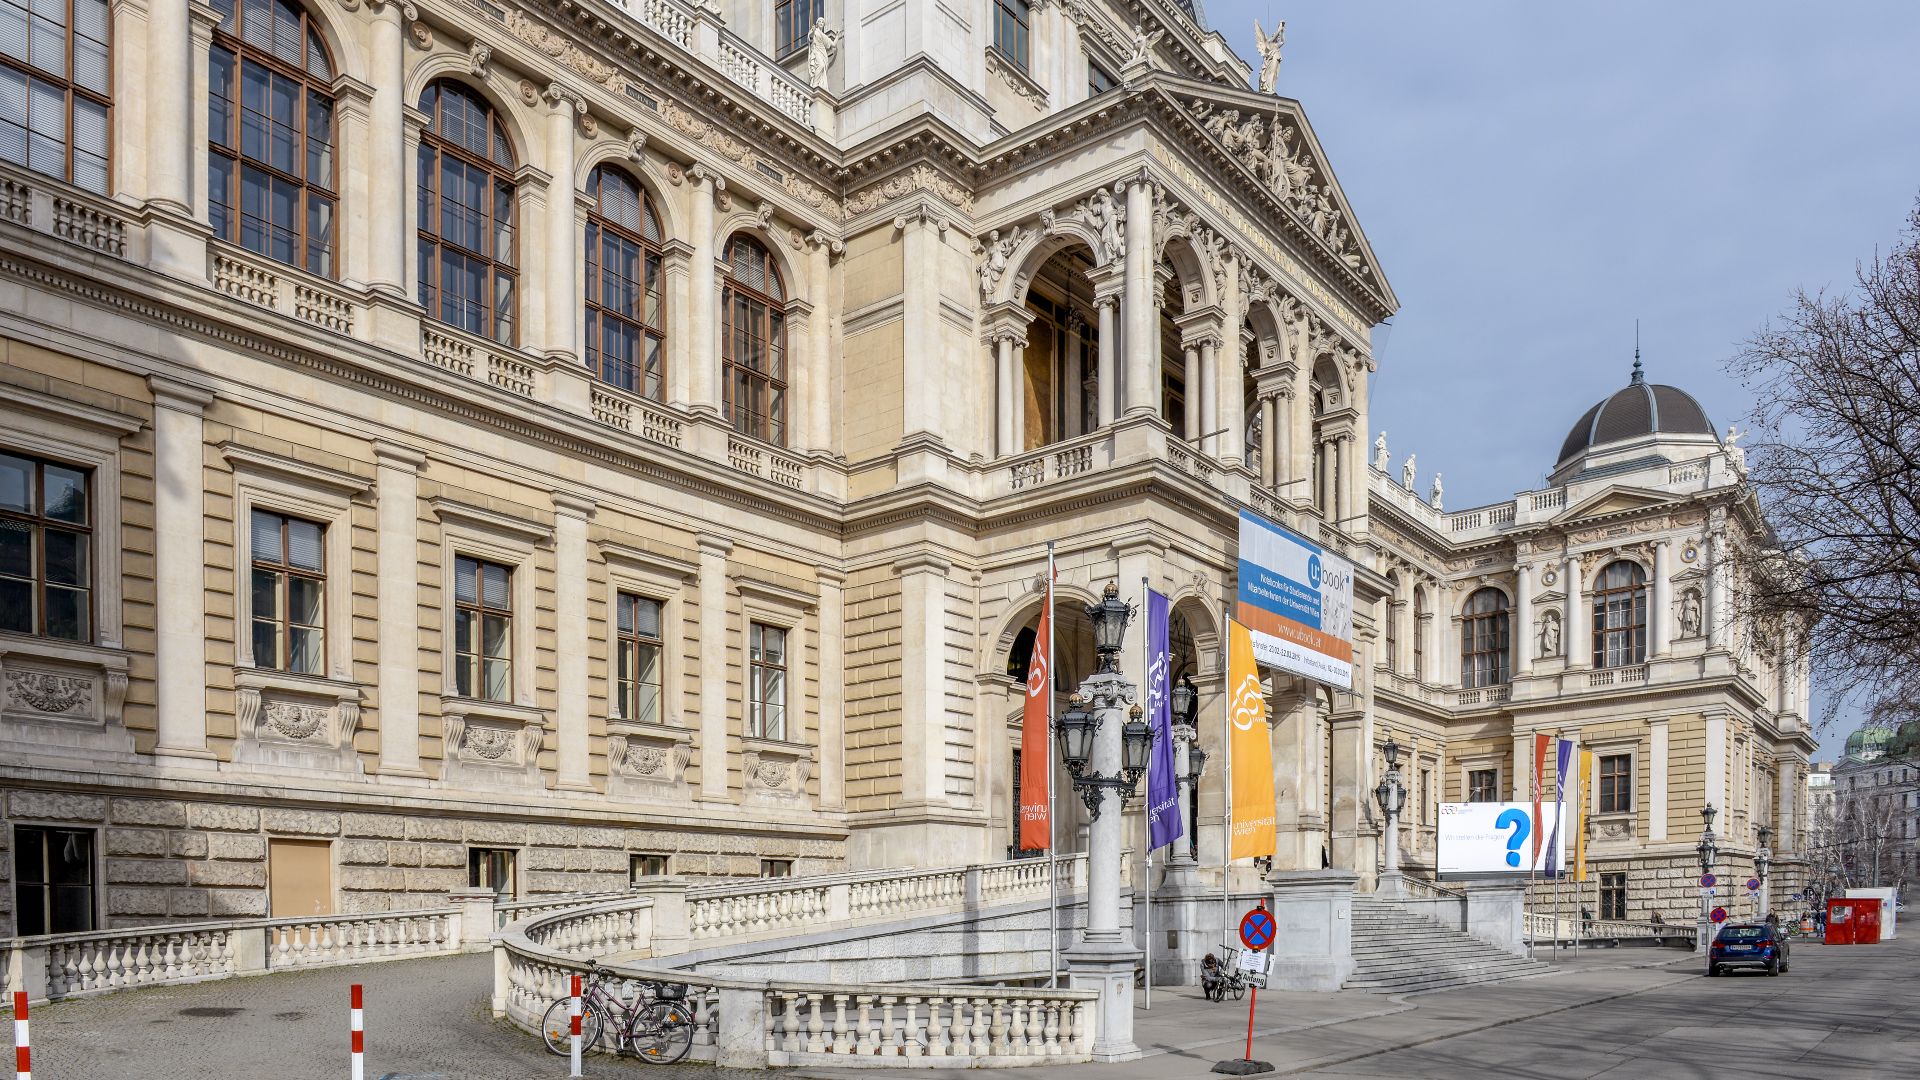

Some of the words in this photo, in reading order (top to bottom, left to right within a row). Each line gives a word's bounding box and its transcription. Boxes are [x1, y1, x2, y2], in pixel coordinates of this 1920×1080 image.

[1233, 816, 1275, 830] universität
[1233, 827, 1256, 836] wien
[1242, 973, 1265, 986] Anfang
